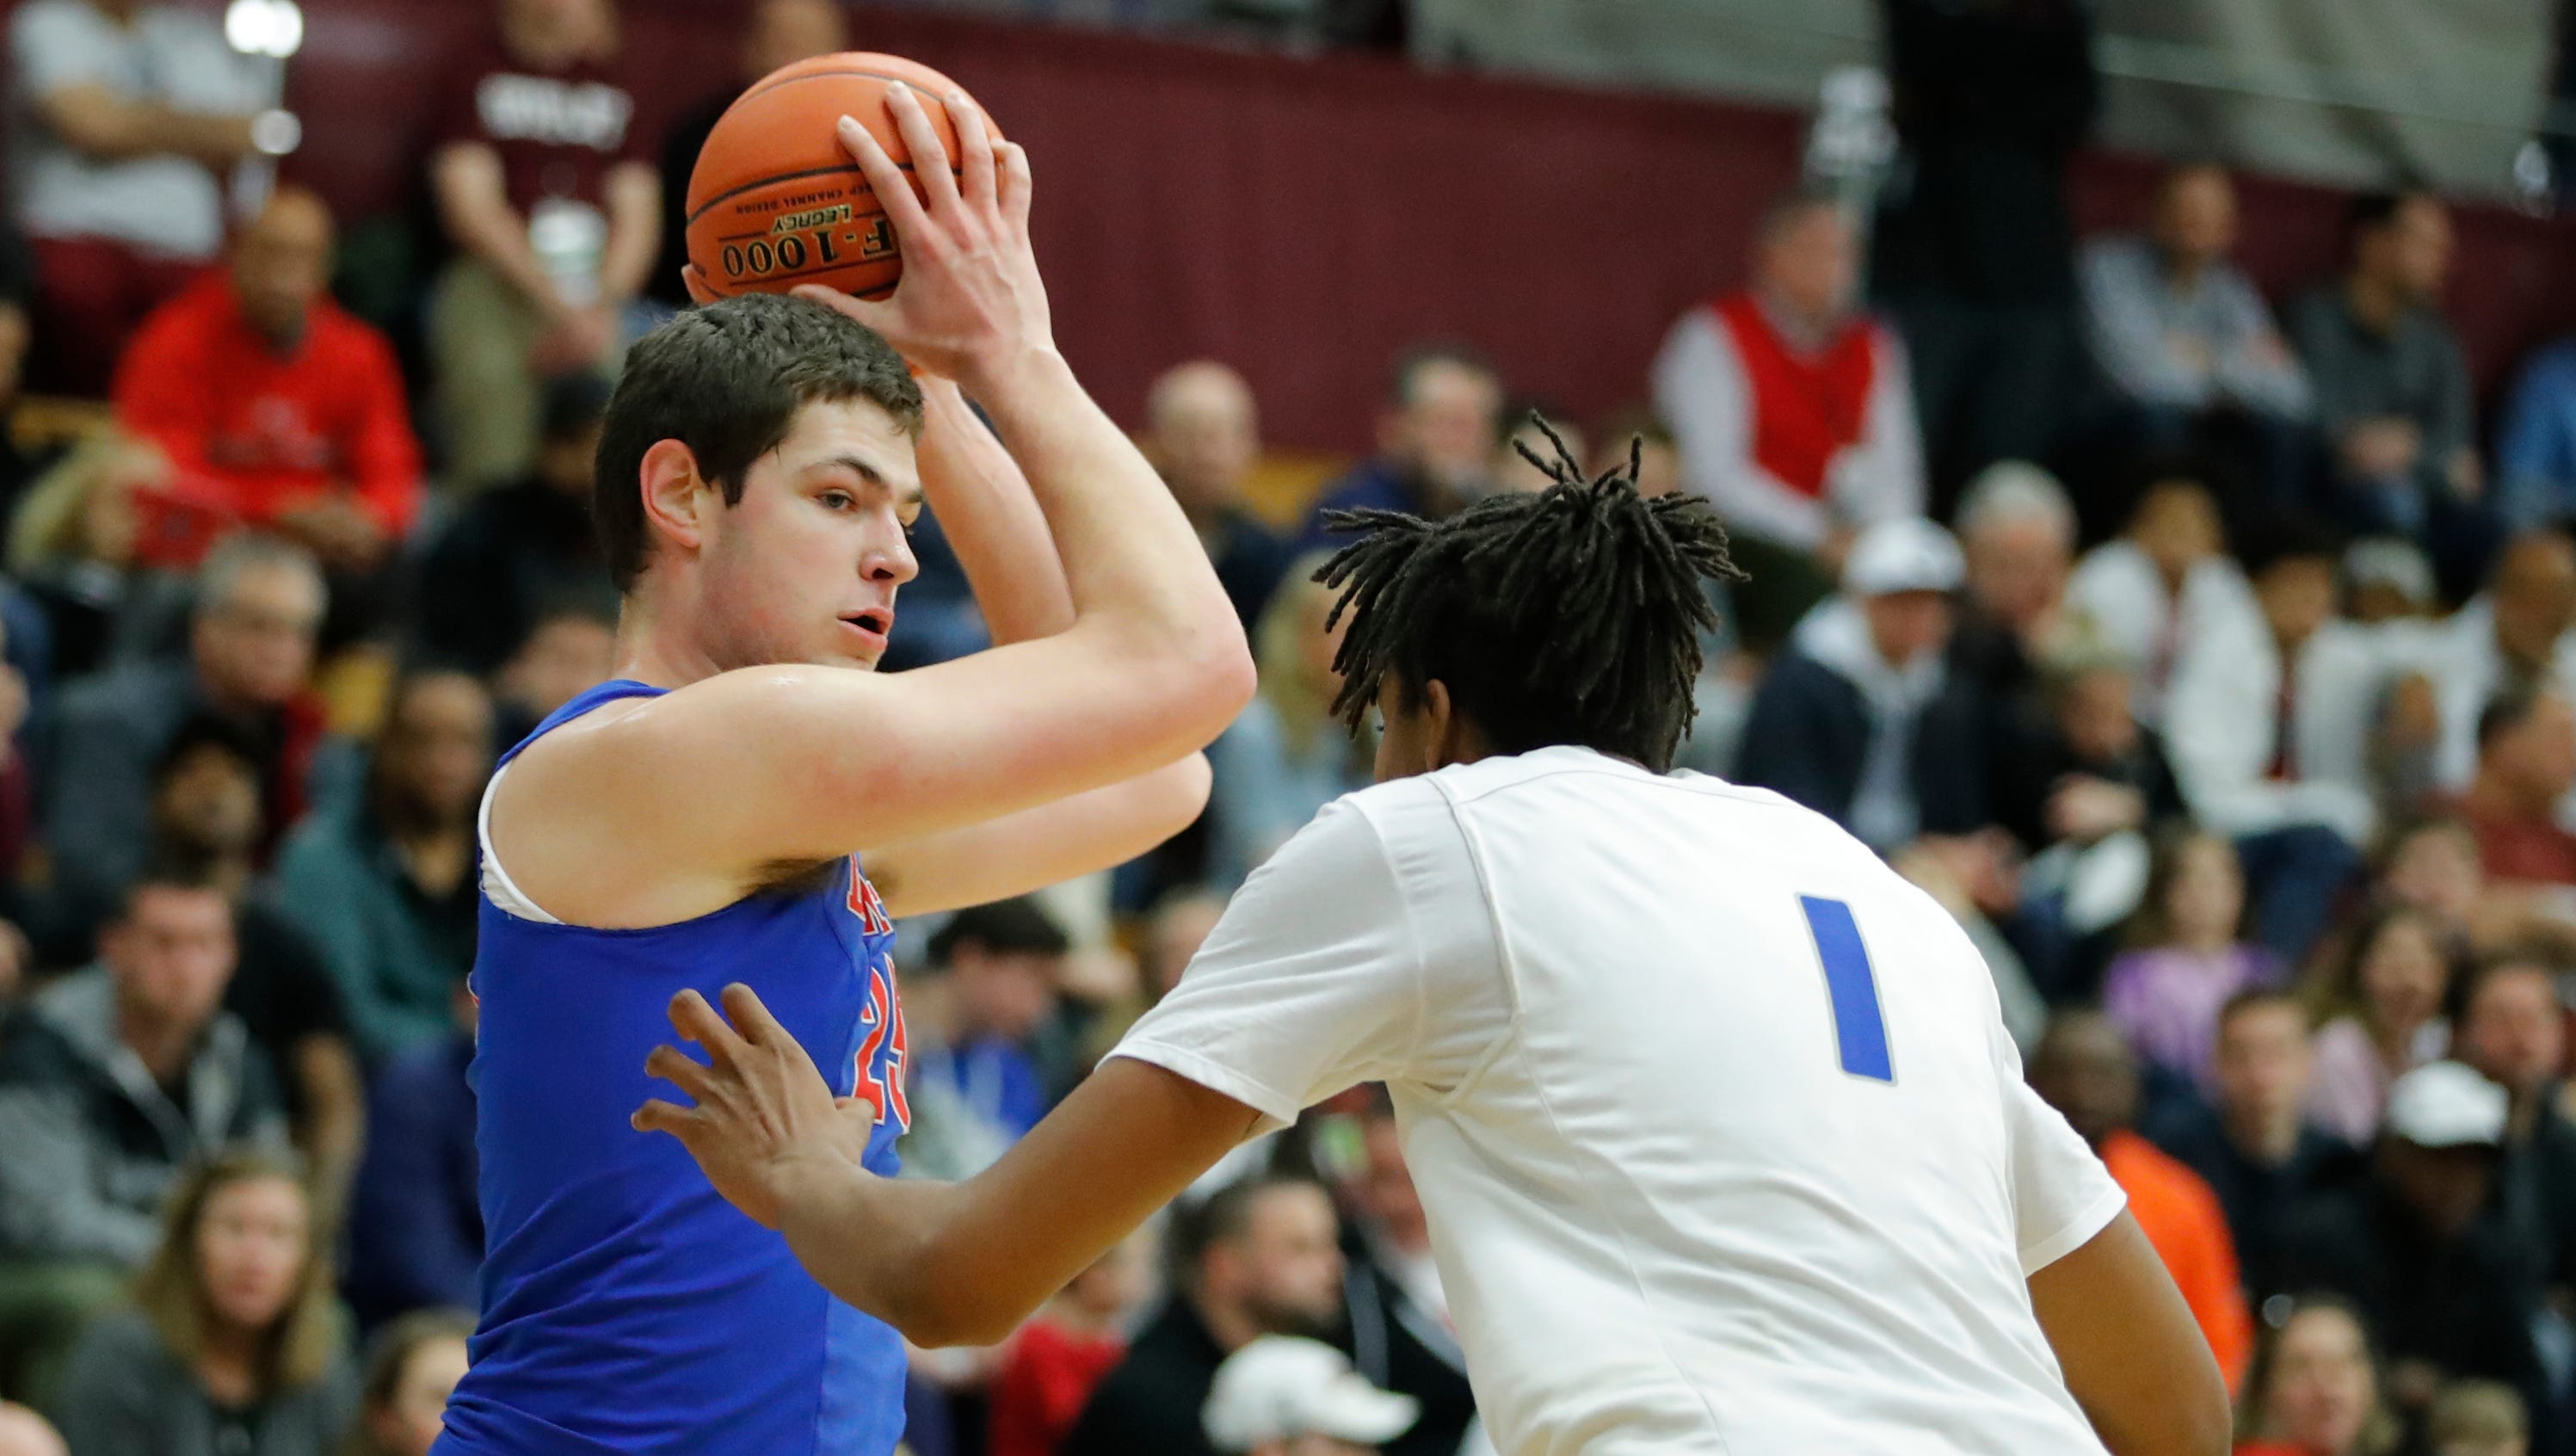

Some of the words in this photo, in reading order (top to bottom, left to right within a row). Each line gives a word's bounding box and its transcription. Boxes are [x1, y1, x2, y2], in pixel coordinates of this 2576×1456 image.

[736, 200, 779, 214] DESIGN
[782, 189, 843, 207] CHANNEL
[772, 203, 852, 234] LEGACY
[723, 219, 893, 277] F-1000
[1795, 891, 1899, 1087] 1
